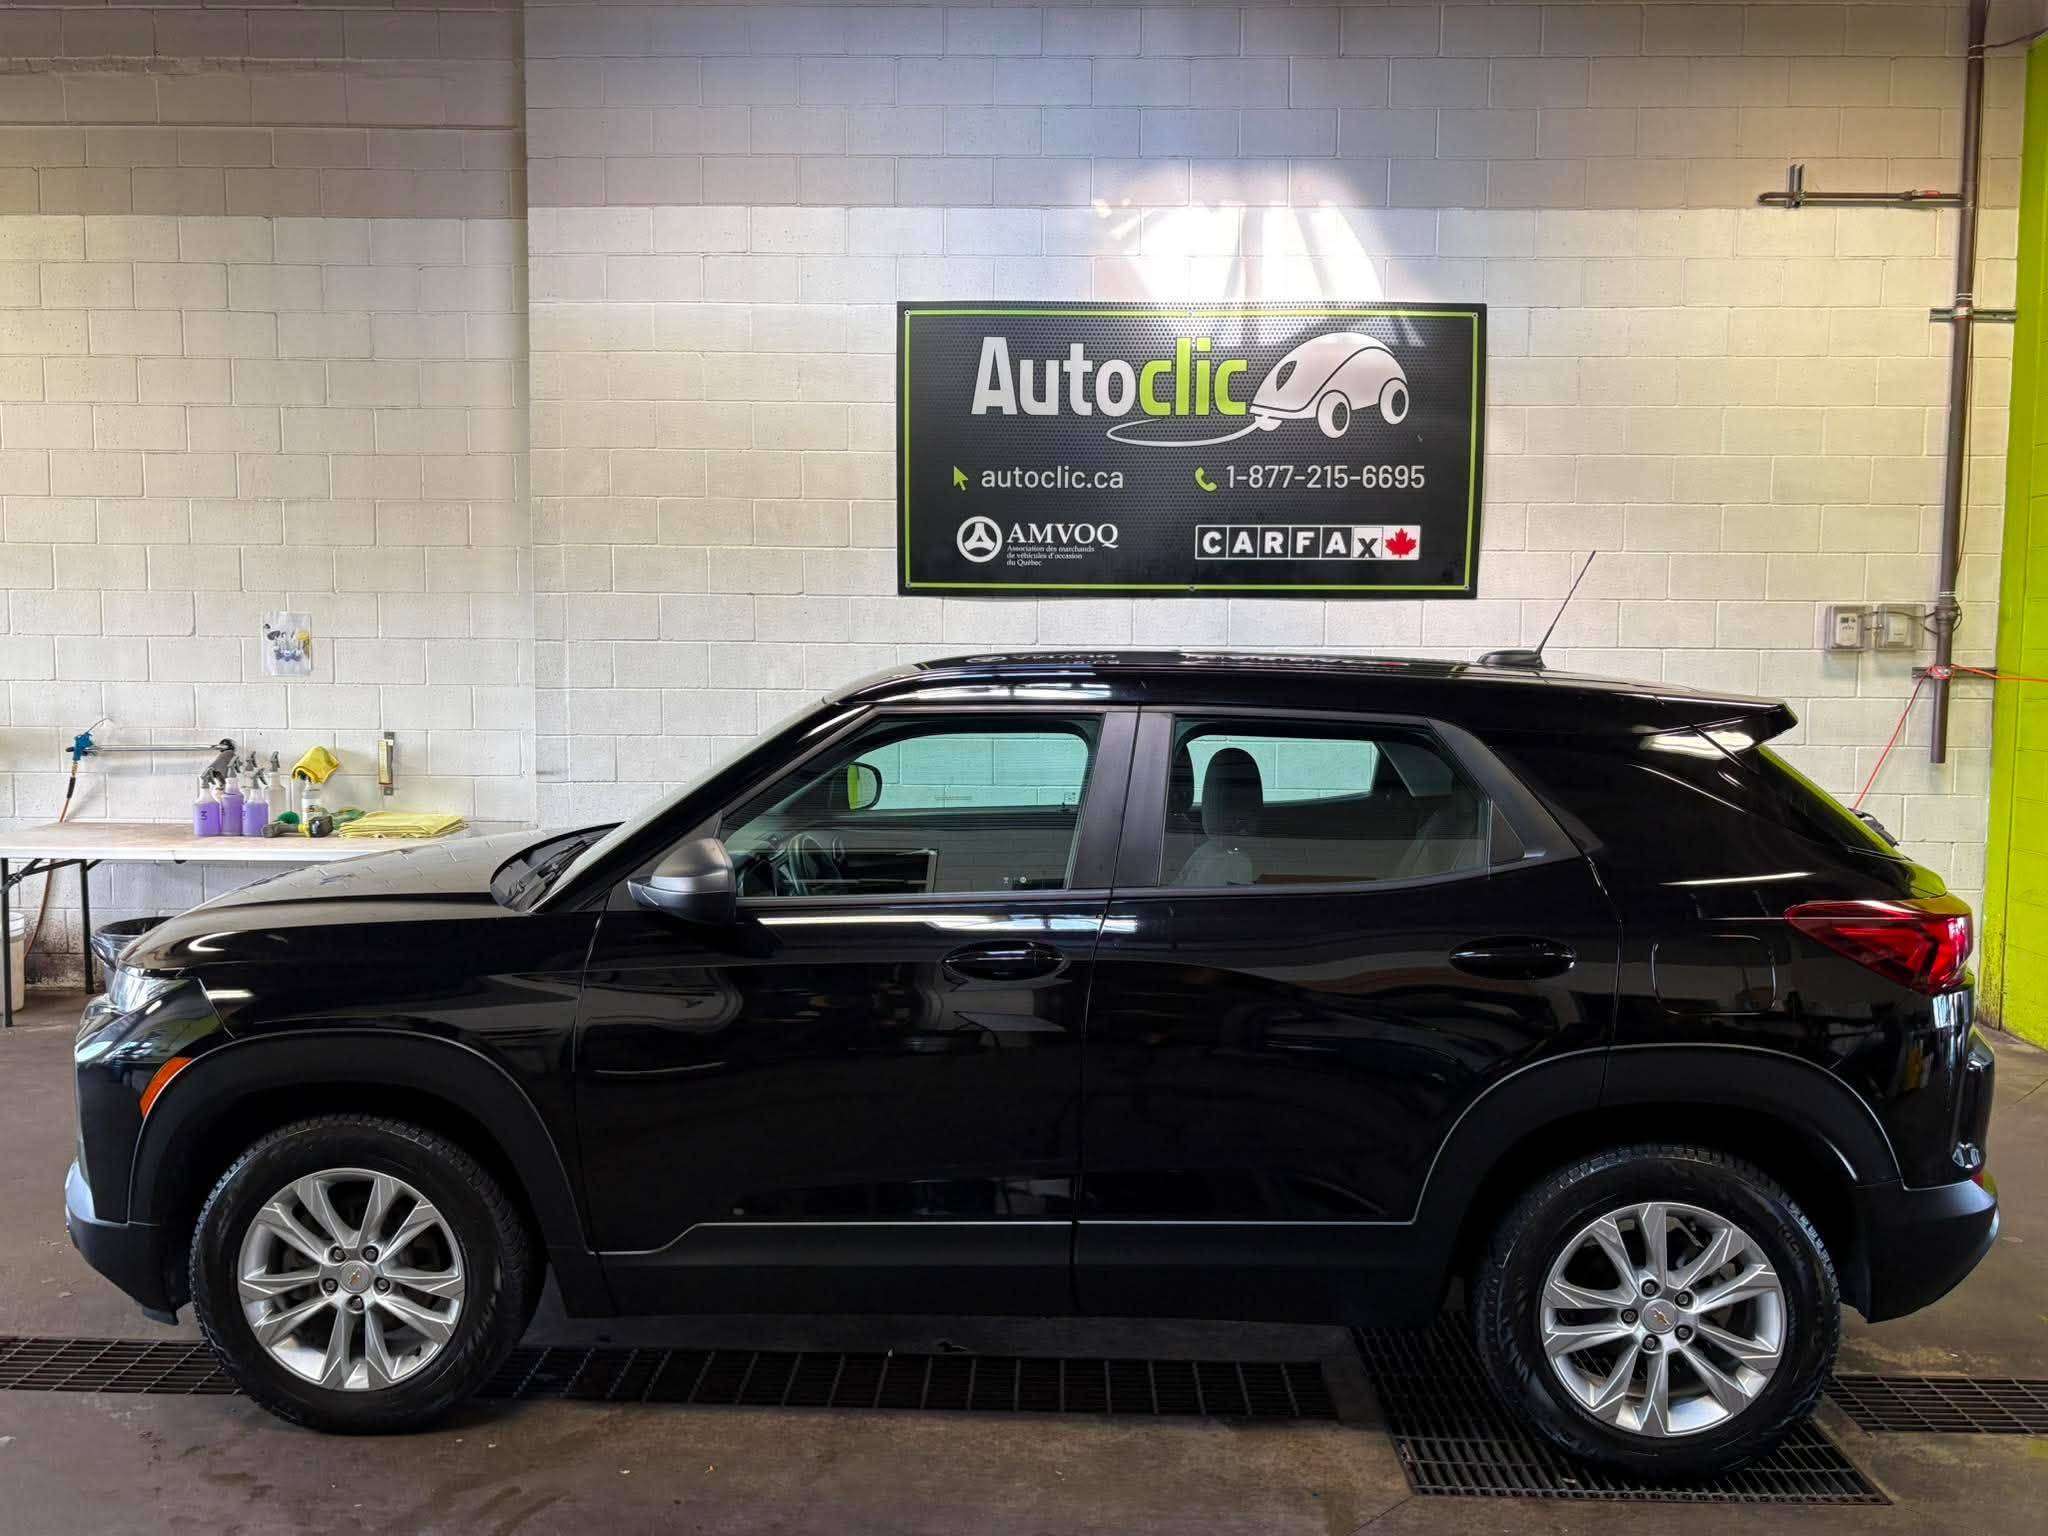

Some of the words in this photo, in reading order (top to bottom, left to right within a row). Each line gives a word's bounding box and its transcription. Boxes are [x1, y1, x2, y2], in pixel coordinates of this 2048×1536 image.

[971, 336, 1248, 417] Autoclic
[981, 466, 1124, 489] autoclic.ca
[1226, 465, 1425, 489] 1-877-215-6695
[1006, 522, 1119, 548] AMVOQ
[1201, 530, 1379, 558] CARFAX
[1007, 544, 1045, 553] Association
[1046, 544, 1057, 552] des
[1058, 545, 1095, 553] marchands
